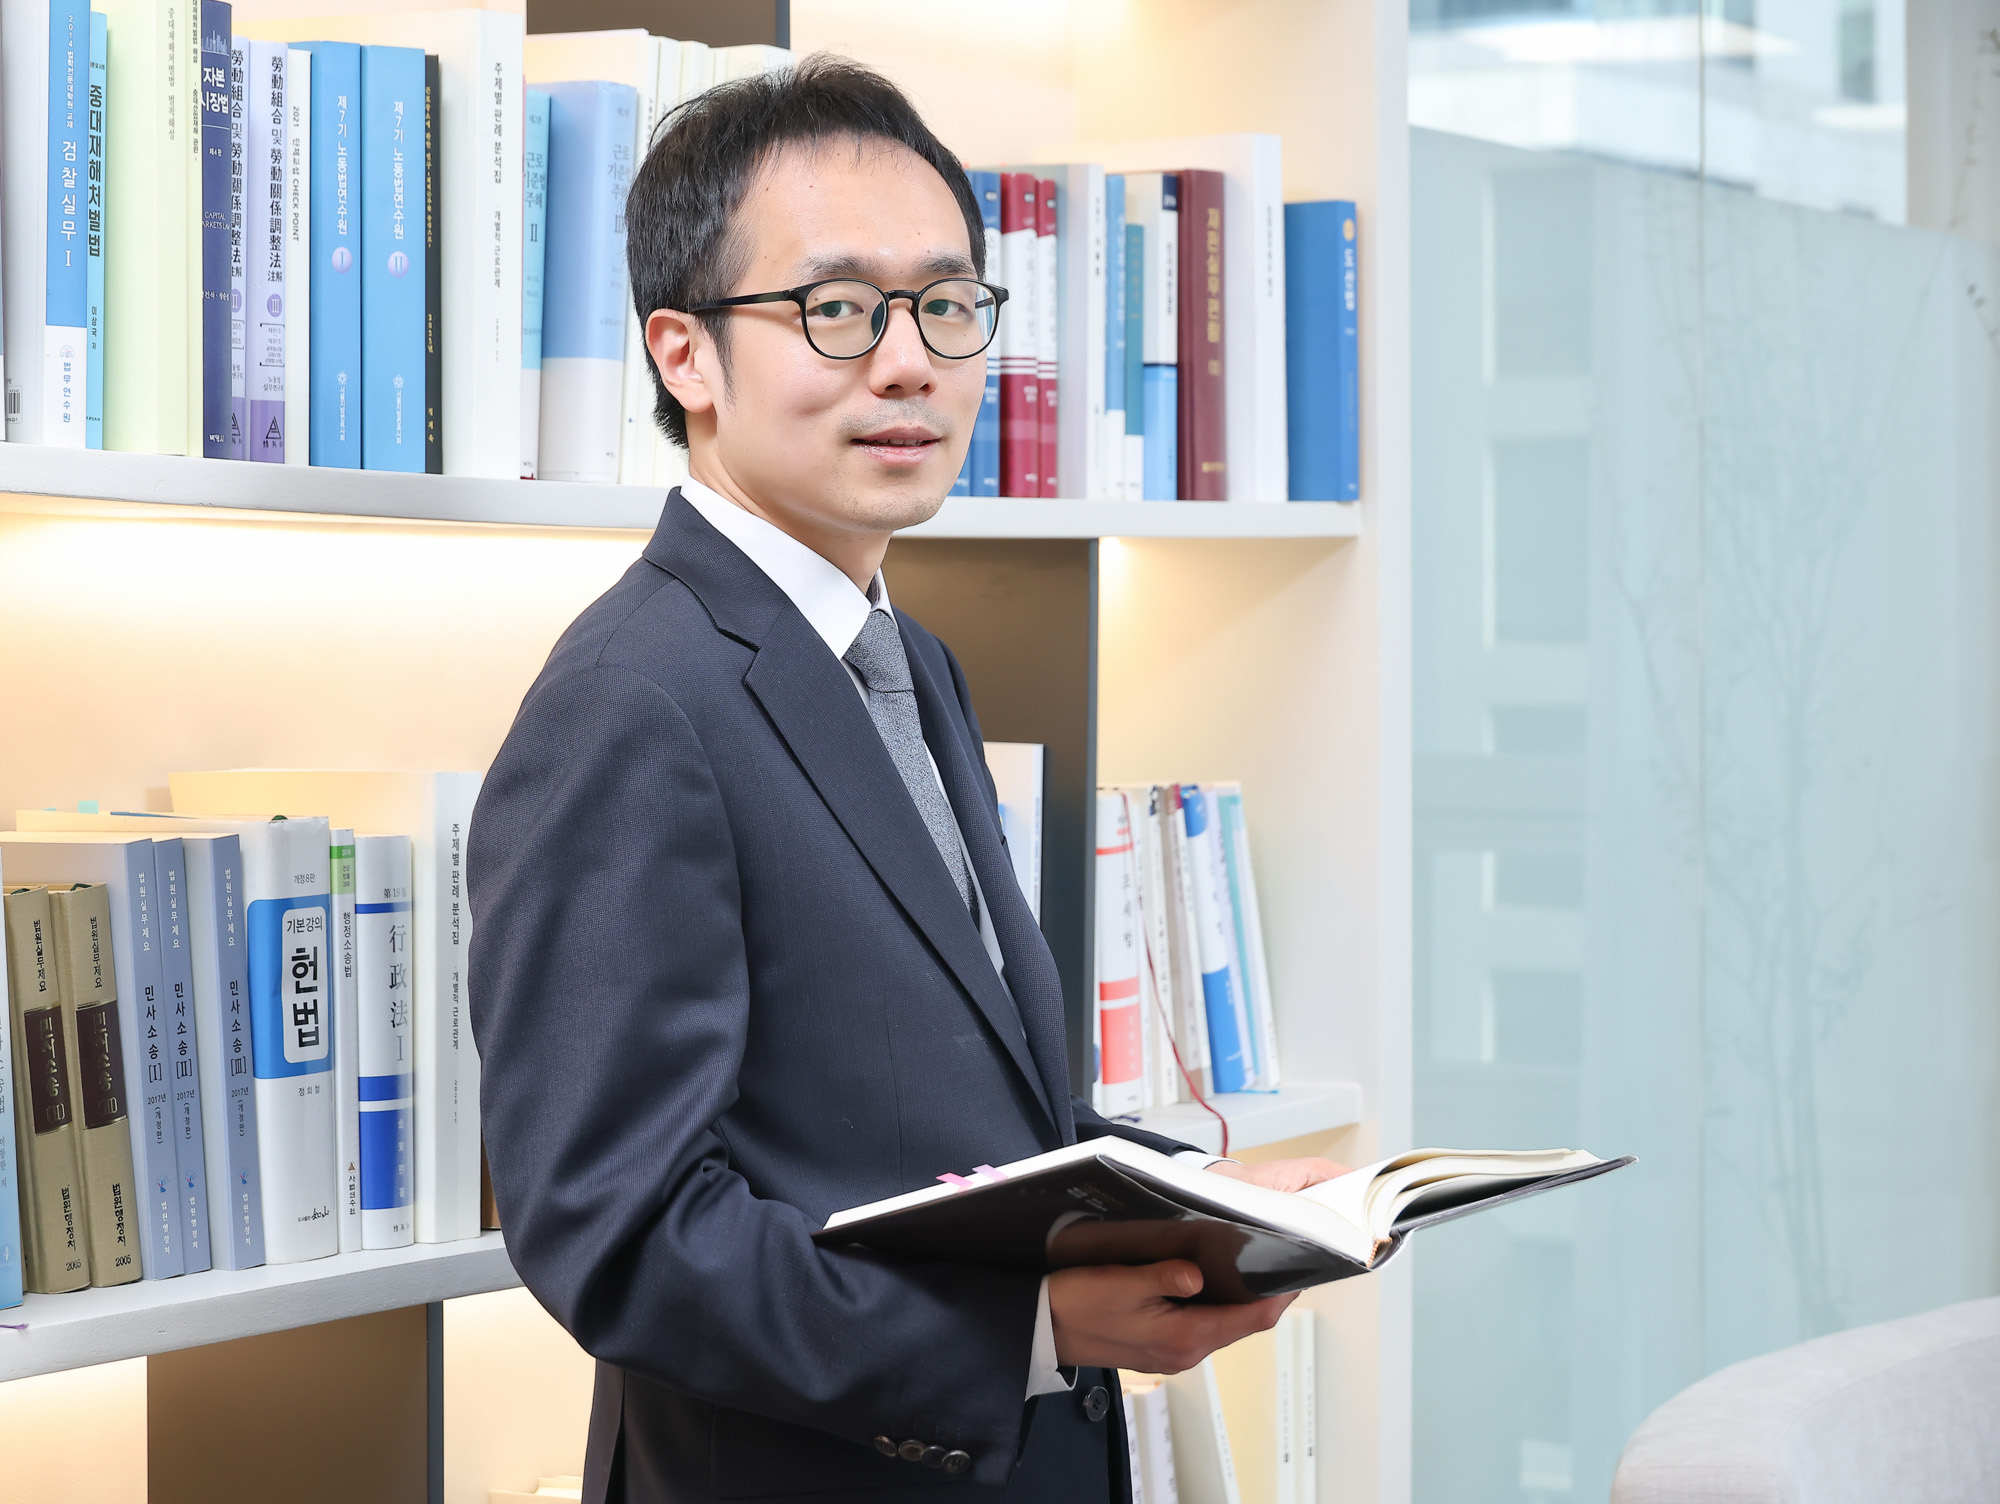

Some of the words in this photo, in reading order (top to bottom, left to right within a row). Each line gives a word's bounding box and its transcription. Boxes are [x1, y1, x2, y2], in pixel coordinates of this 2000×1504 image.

[67, 15, 75, 48] 2014
[203, 66, 225, 89] 자본
[337, 95, 347, 138] 제7기
[393, 101, 404, 143] 제7기
[60, 140, 77, 241] 검찰실무
[88, 84, 103, 257] 중대재해처벌법
[337, 142, 348, 235] 노동법연수원
[393, 147, 404, 240] 노동법연수원
[204, 211, 226, 221] CAPITAL
[63, 362, 71, 423] 법무연수원
[168, 870, 180, 948] 법원실무제요
[224, 868, 235, 947] 법원실무제요
[293, 873, 316, 885] 개정8판
[138, 872, 150, 951] 법원실무제요
[286, 915, 323, 934] 기본강의
[90, 916, 103, 989] 법원실무제요
[342, 912, 352, 978] 행정소송법
[291, 946, 320, 1048] 헌법
[388, 924, 408, 1029] 行政法
[144, 985, 159, 1060] 민사소송
[174, 982, 188, 1056] 민사소송
[229, 980, 243, 1054] 민사소송
[147, 1093, 167, 1105] 2017년
[176, 1089, 195, 1101] 2017년
[231, 1086, 249, 1098] 2017년
[112, 1183, 126, 1247] 법원행정처
[161, 1201, 171, 1255] 법원행정처
[189, 1196, 198, 1249] 법원행정처
[242, 1192, 251, 1246] 법원행정처
[66, 1259, 82, 1272] 2005
[115, 1254, 132, 1267] 2005
